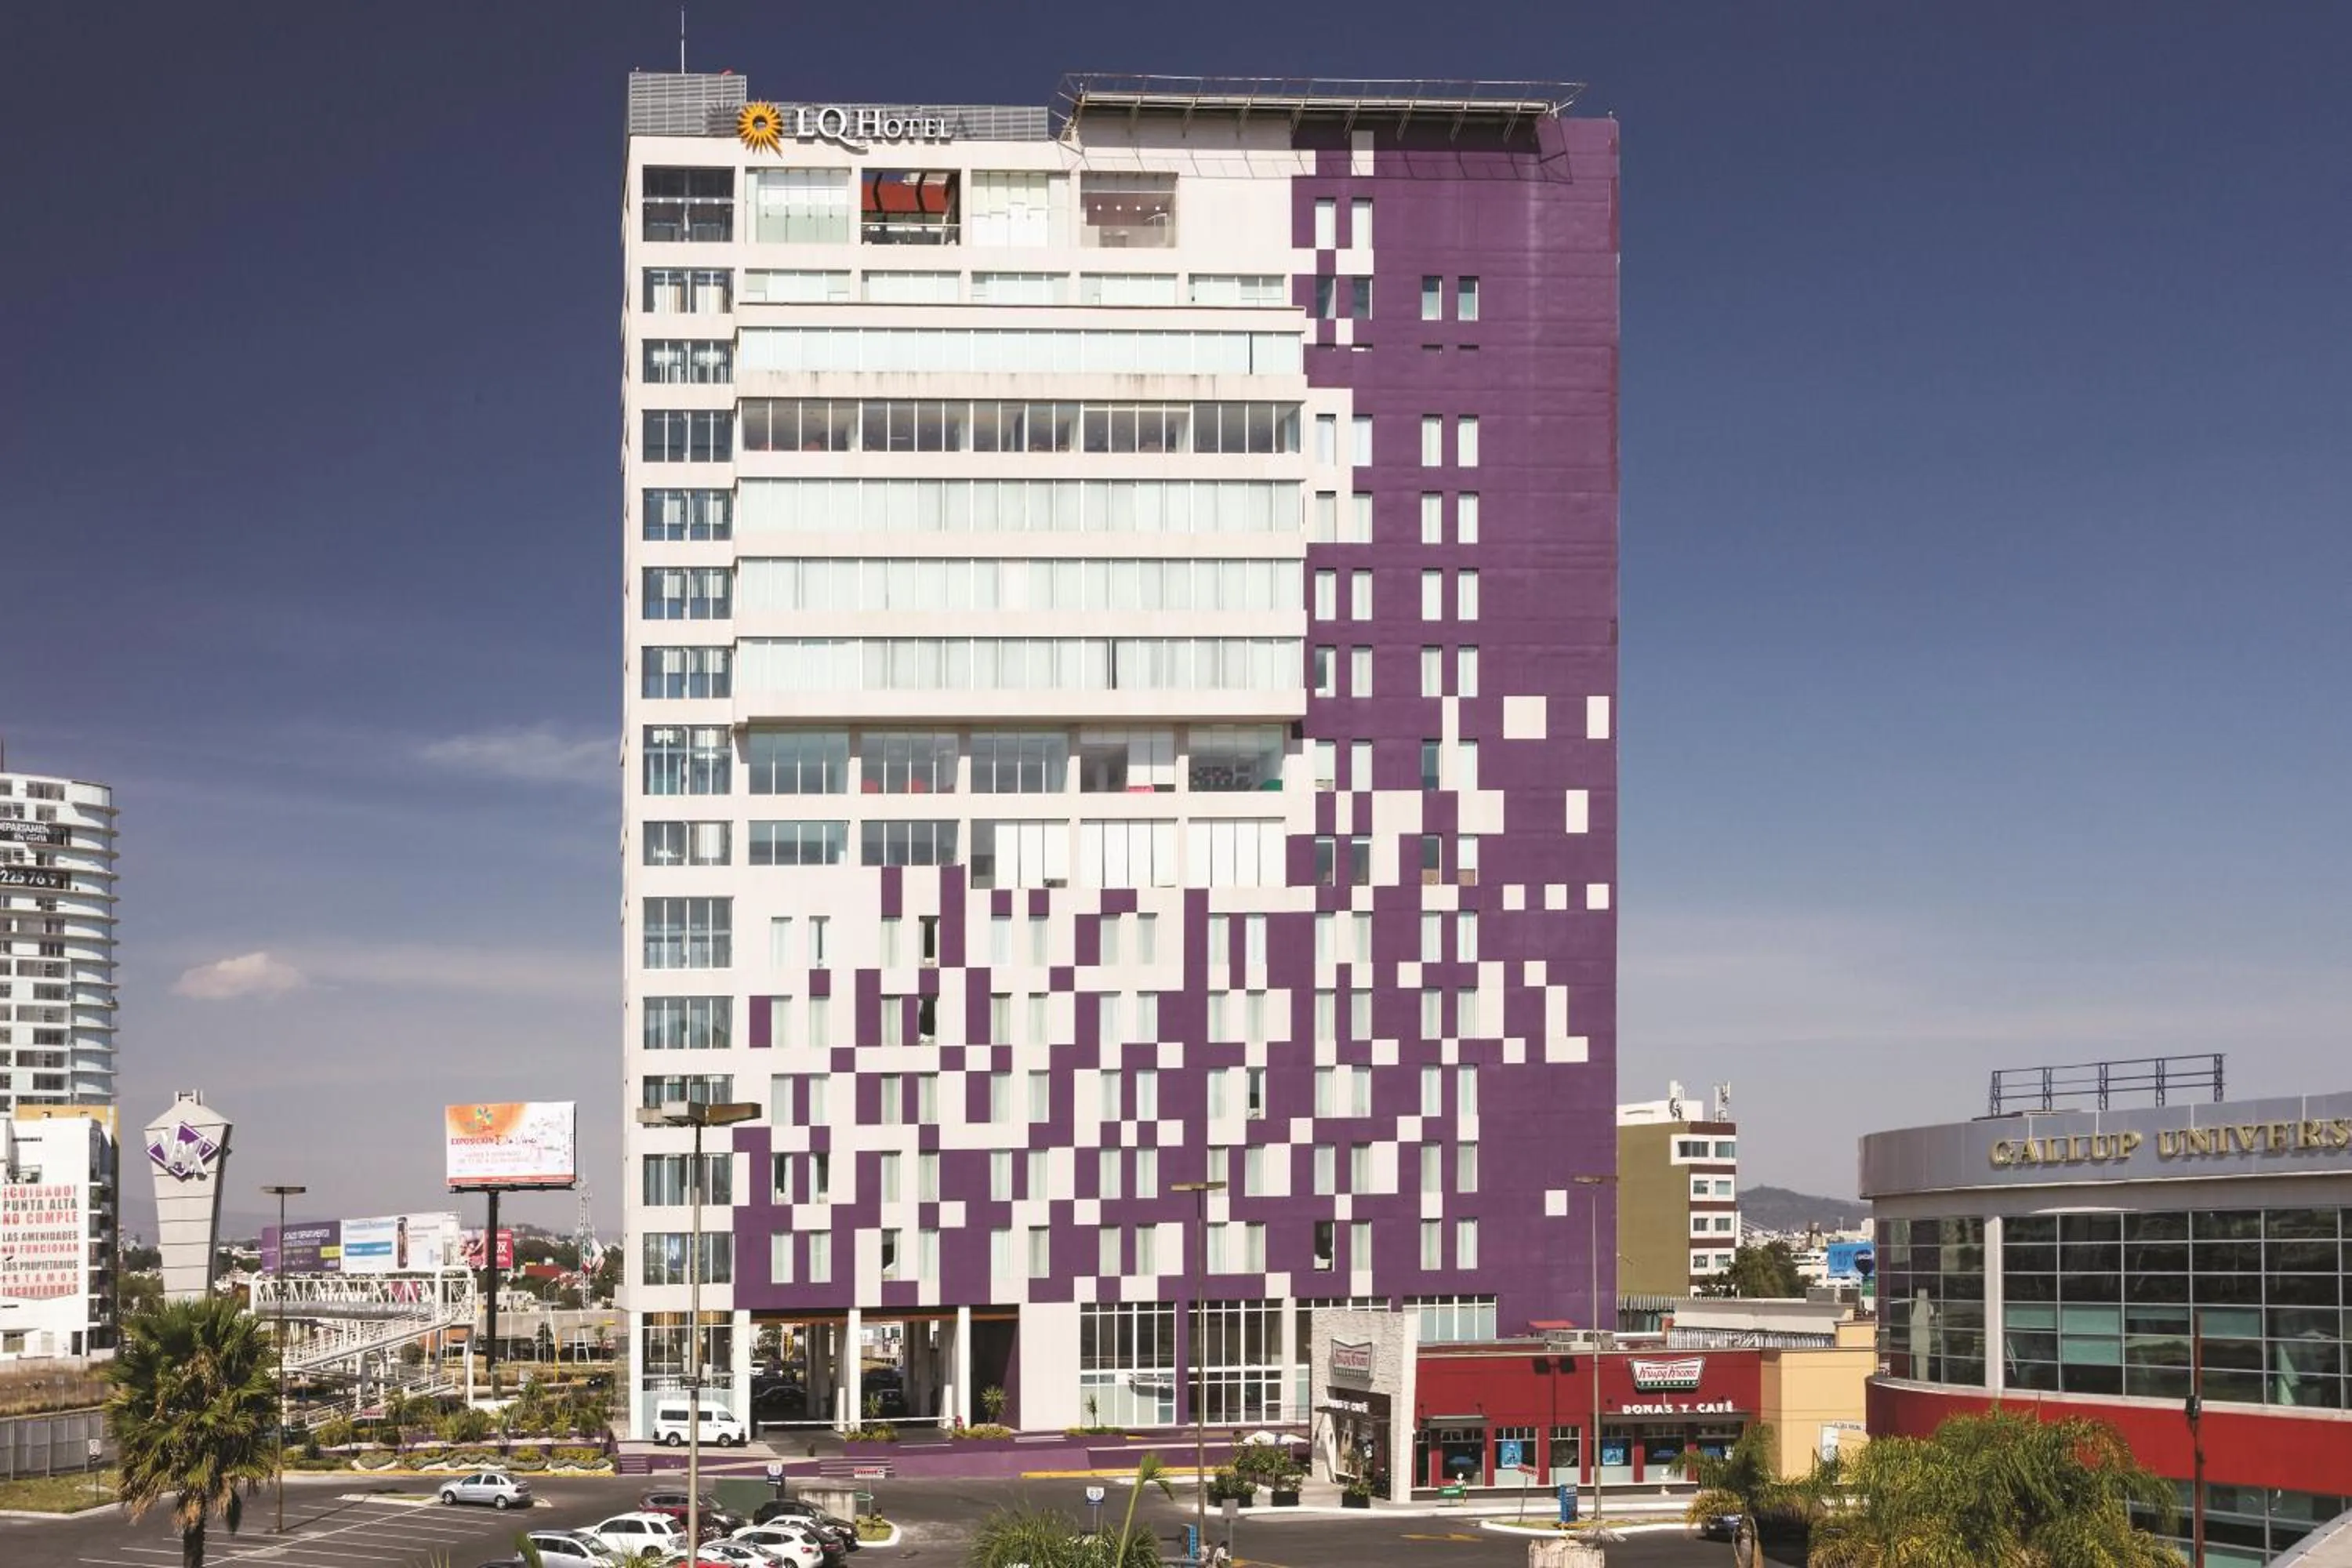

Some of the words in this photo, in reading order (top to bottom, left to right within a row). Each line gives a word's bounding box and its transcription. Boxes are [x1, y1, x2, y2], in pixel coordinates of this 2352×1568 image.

[795, 107, 867, 147] LQ
[1992, 1131, 2143, 1165] GALLUP
[2158, 1117, 2352, 1158] UNIVERS
[3, 1200, 44, 1210] PUNTA
[49, 1198, 78, 1210] ALTA
[3, 1213, 20, 1225] NO
[27, 1211, 78, 1224] CUMPLE
[3, 1232, 18, 1242] LAS
[21, 1230, 78, 1241] AMENIDADES
[20, 1243, 78, 1254] FUNCIONAN
[2, 1261, 17, 1271] LOS
[20, 1260, 78, 1270] PROPIETARIOS
[2, 1272, 78, 1283] ESTAMOS
[2, 1284, 78, 1295] INCONFORMES
[1622, 1404, 1673, 1414] DONAS
